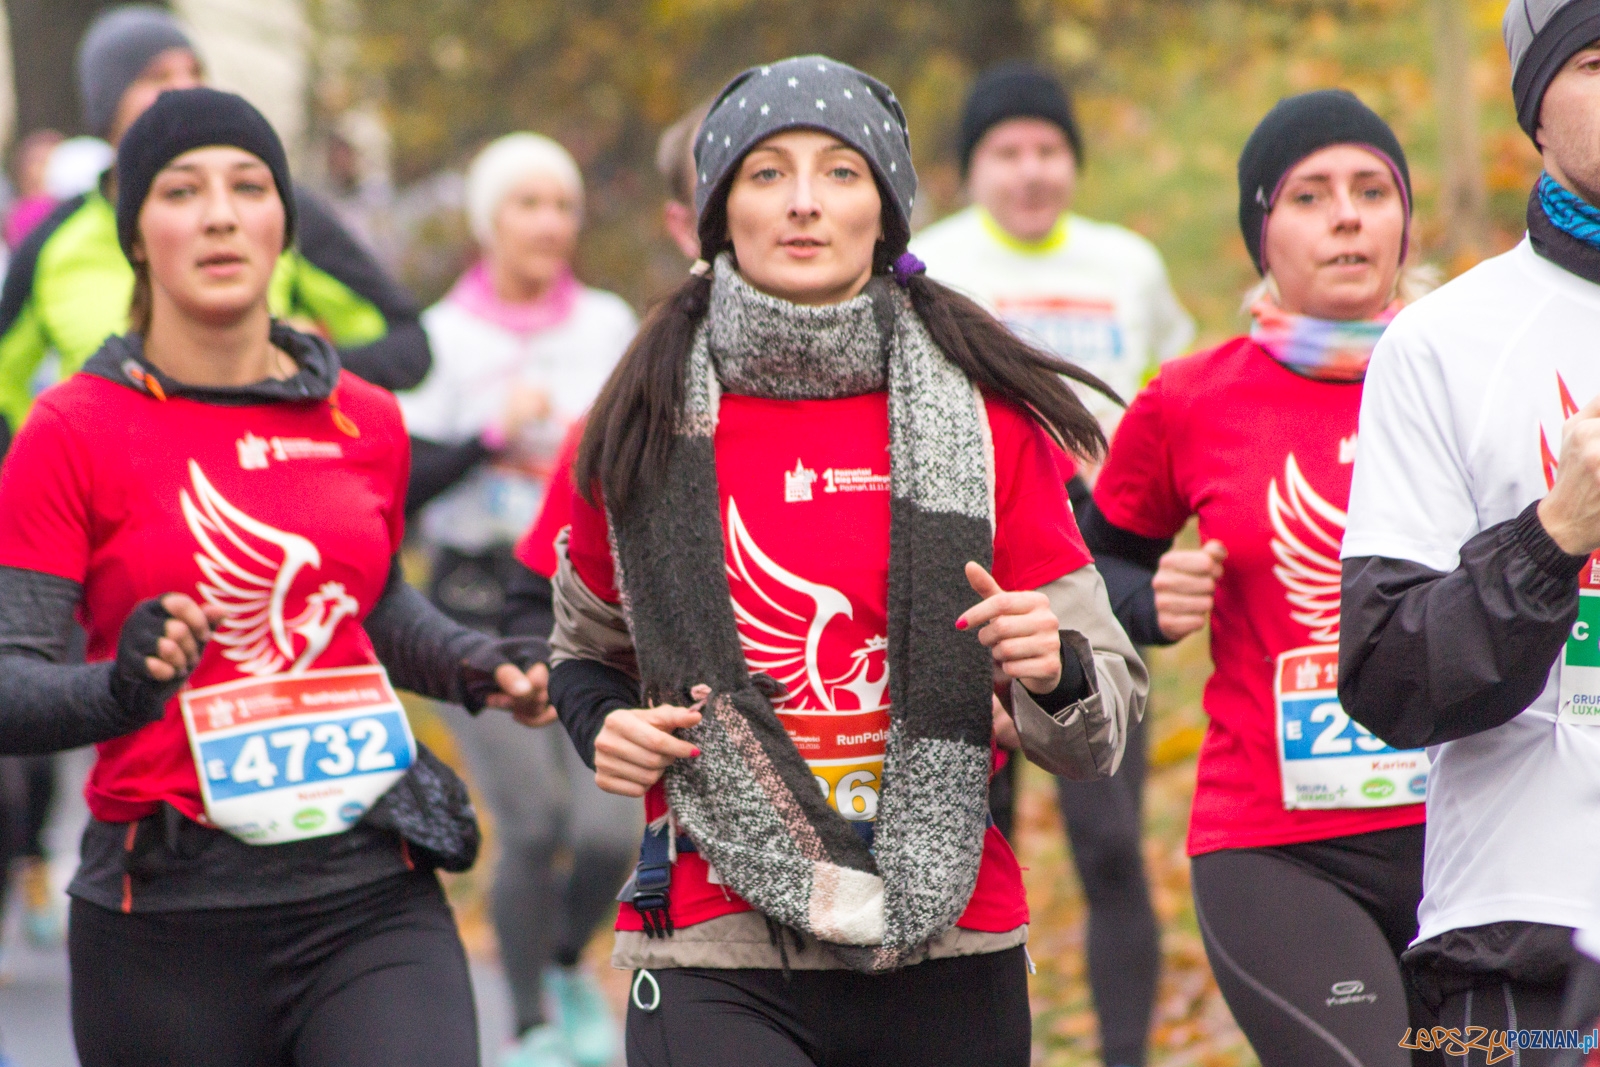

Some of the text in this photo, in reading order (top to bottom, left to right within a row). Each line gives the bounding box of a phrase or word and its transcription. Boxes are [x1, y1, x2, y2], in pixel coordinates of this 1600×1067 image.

[822, 467, 838, 493] 1
[1571, 621, 1590, 641] C
[1286, 720, 1303, 741] E
[206, 719, 396, 787] E 4732
[1371, 760, 1418, 771] Karina
